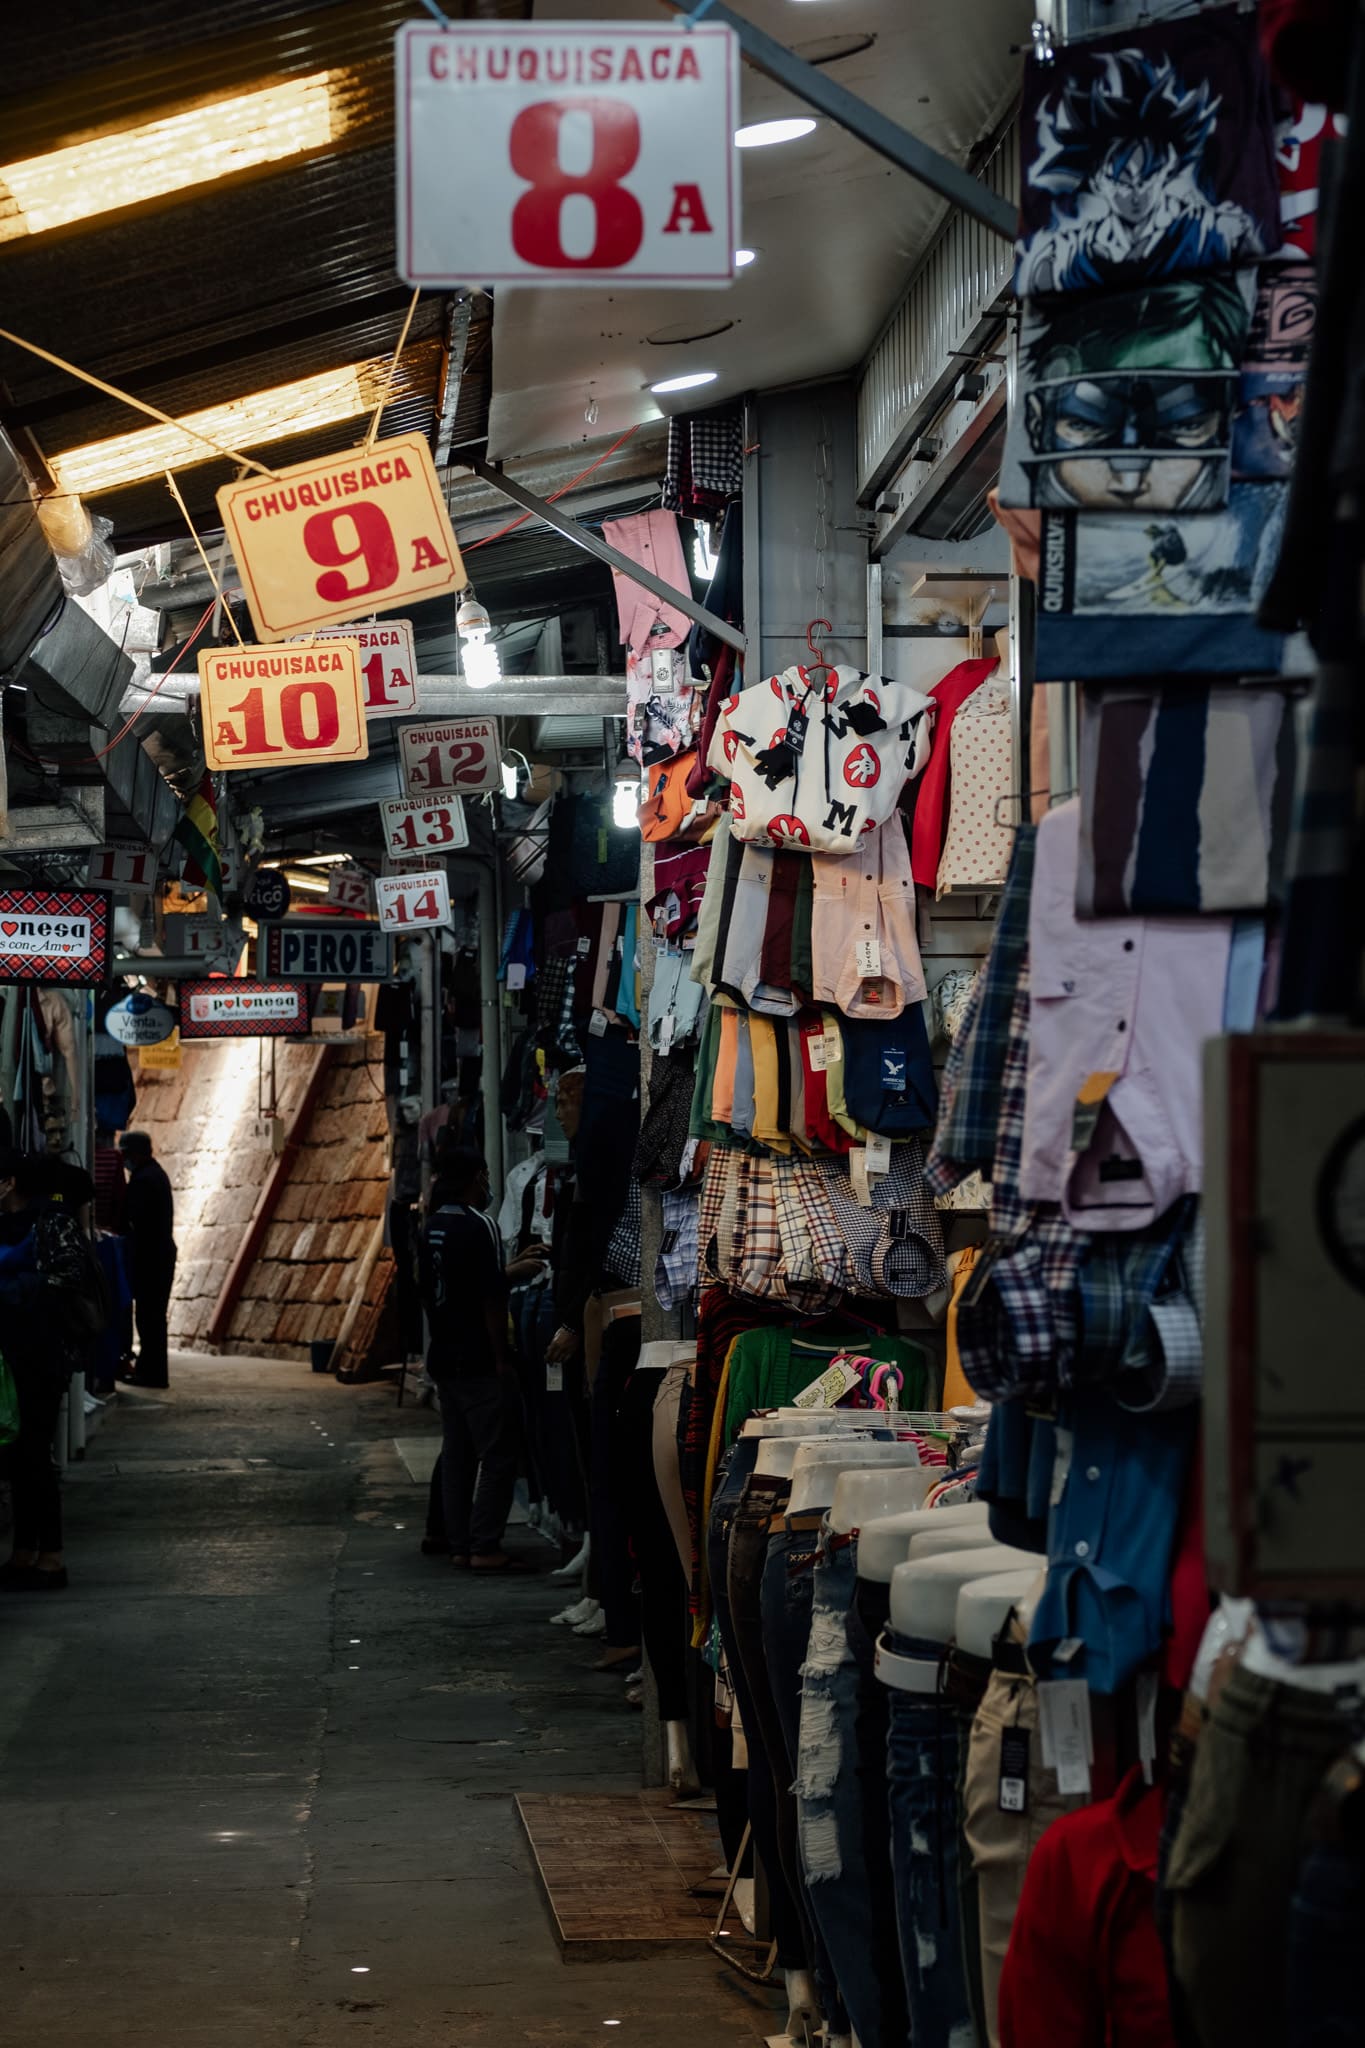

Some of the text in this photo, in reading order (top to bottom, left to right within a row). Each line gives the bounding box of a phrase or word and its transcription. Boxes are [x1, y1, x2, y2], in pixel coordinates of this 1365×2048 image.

[428, 45, 702, 82] CHUQUISACA
[508, 97, 644, 269] 8
[244, 457, 412, 522] CHUQUISACA
[303, 501, 399, 603] 9
[215, 653, 344, 681] CHUQUISACA
[410, 725, 489, 745] CHUQUISACA
[388, 795, 453, 814] CHUQUISACA
[93, 851, 149, 885] 11
[383, 878, 440, 893] CHUQUISACA
[8, 940, 30, 951] con
[122, 1015, 156, 1028] Venta
[117, 1028, 162, 1042] Tarjetas
